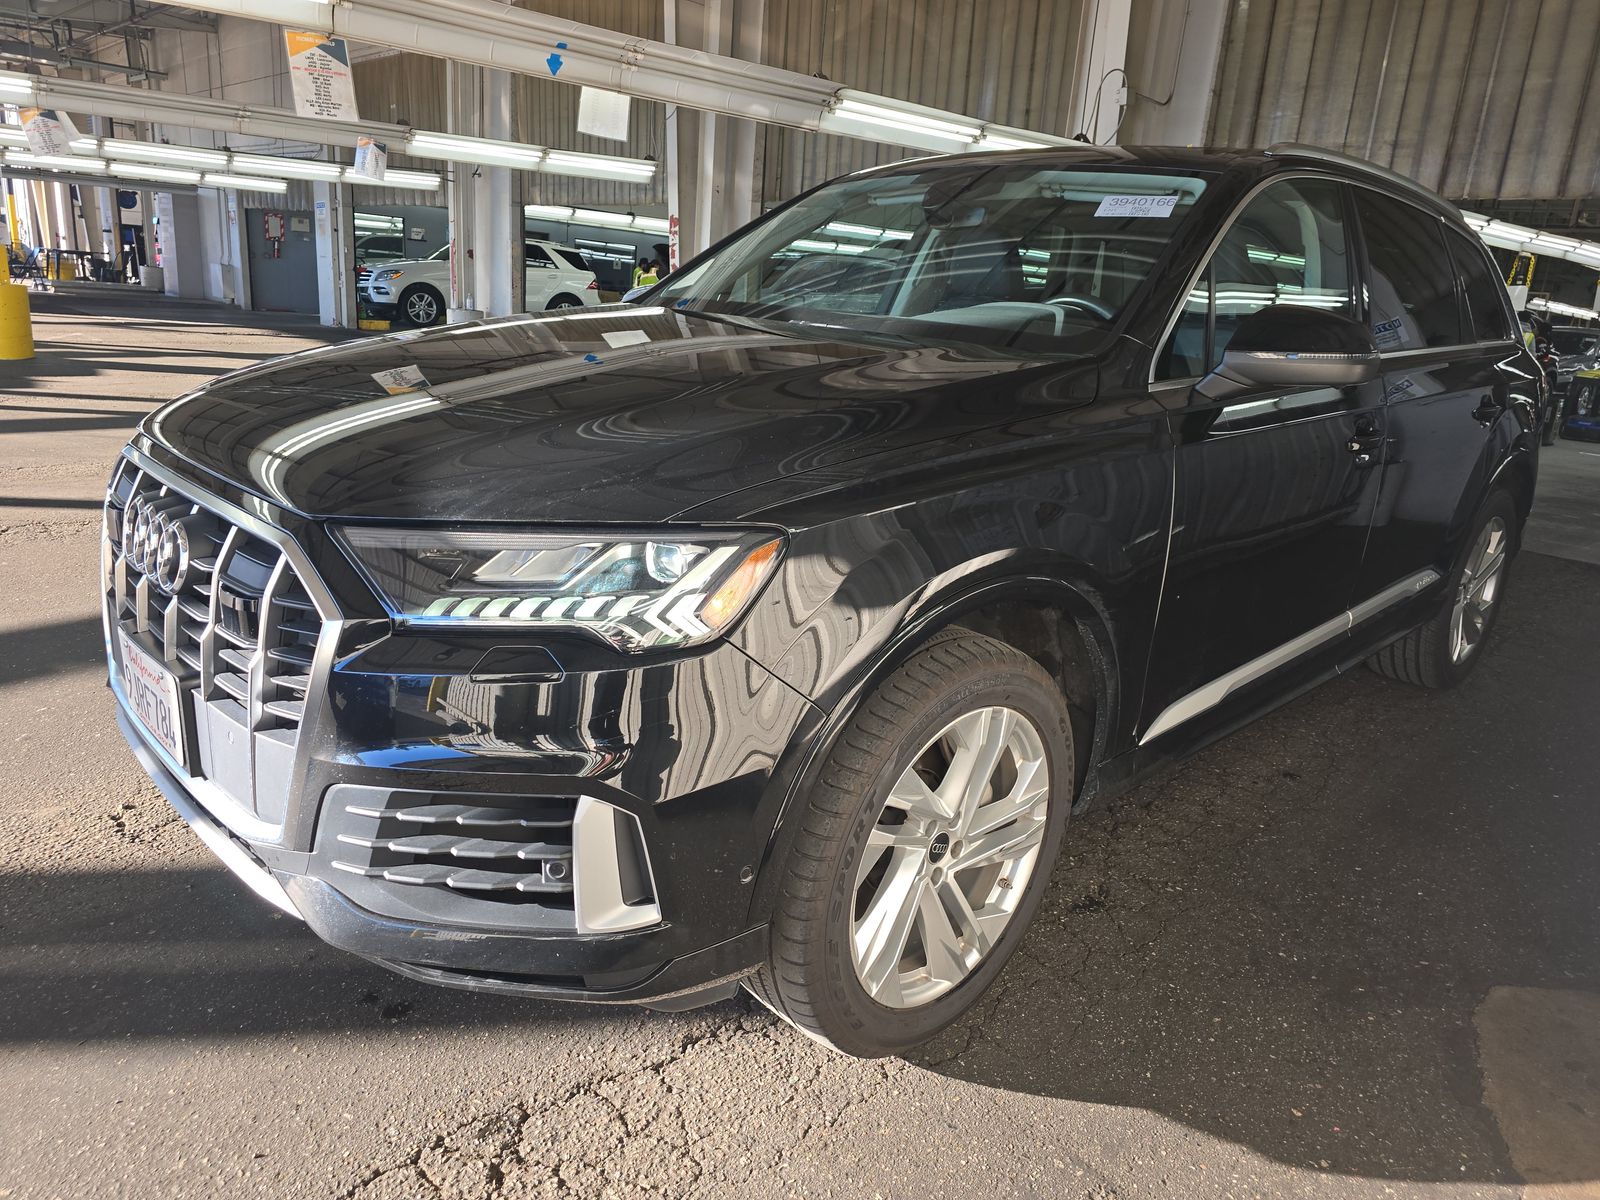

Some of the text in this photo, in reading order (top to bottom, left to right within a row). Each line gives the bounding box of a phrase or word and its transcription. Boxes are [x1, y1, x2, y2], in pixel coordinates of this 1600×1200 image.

[1109, 197, 1178, 207] 3940166
[125, 663, 177, 749] 9JRF784
[833, 788, 878, 923] SPORT
